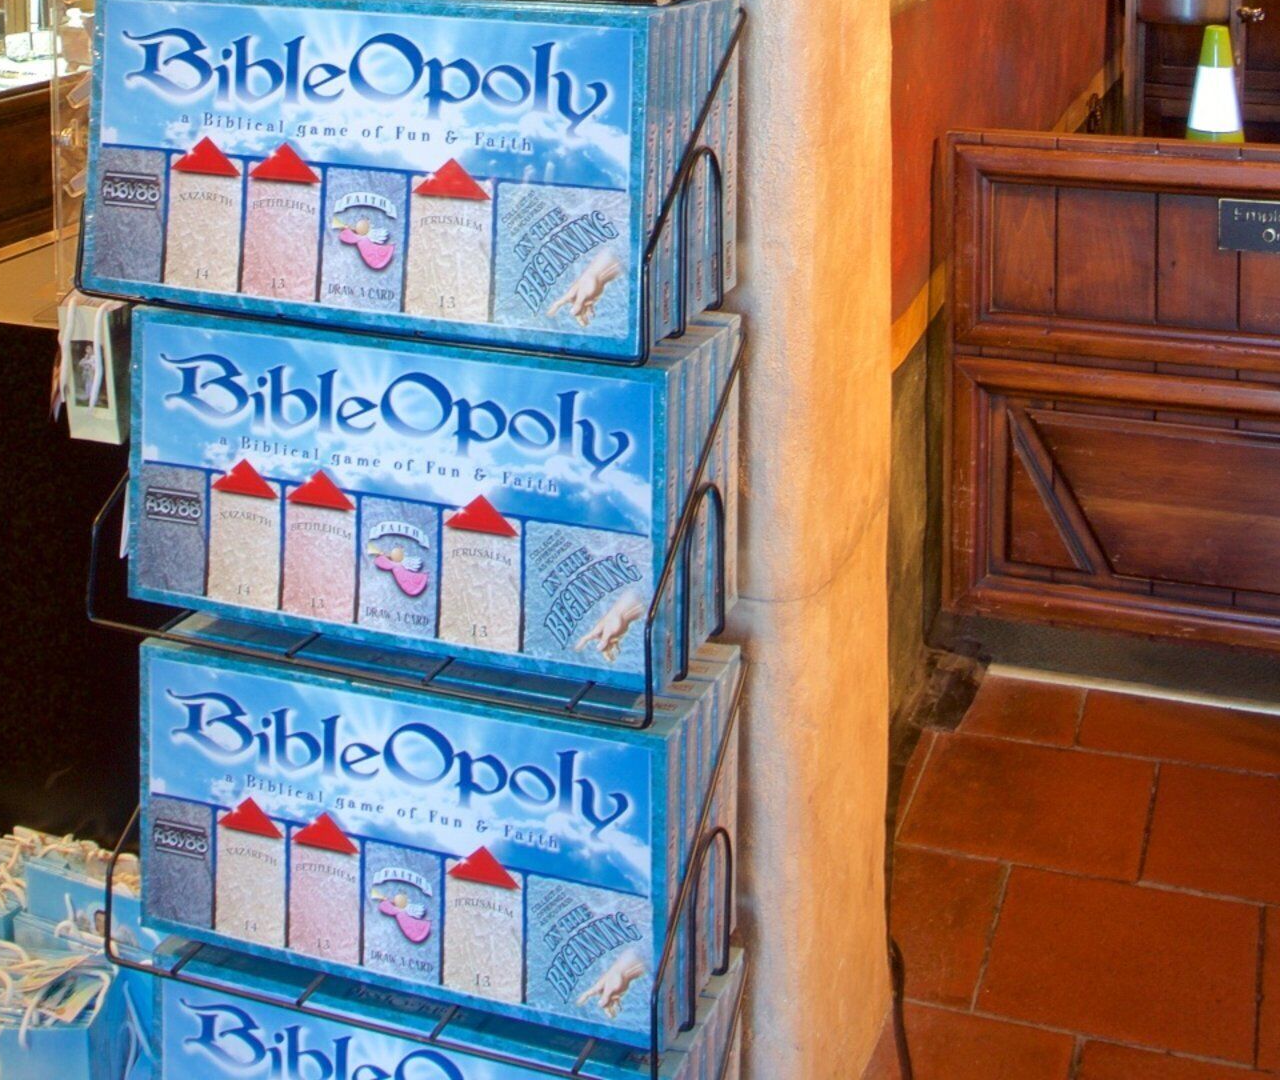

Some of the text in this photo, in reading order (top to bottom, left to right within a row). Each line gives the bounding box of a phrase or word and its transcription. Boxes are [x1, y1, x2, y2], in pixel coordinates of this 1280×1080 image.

[122, 28, 608, 136] BibleOpoly
[181, 112, 534, 152] a Biblical game of Fun & Faith
[346, 195, 387, 207] FAITH
[420, 215, 483, 232] JERUSALEM
[513, 207, 570, 262] IN THE
[196, 268, 209, 280] 14
[515, 210, 620, 315] BEGINNING
[271, 278, 286, 289] 13
[439, 295, 456, 308] 13
[160, 353, 630, 480] BibleOpoly
[220, 436, 558, 493] a Biblical game of Fun & Faith
[380, 523, 419, 537] FAITH
[451, 548, 512, 567] JERUSALEM
[542, 546, 594, 597] IN THE
[542, 552, 643, 650] BEGINNING
[472, 624, 488, 638] 13
[167, 689, 629, 838] BibleOpoly
[225, 774, 559, 849] a Biblical game of Fun & Faith
[384, 869, 423, 884] FAITH
[454, 898, 514, 918] JERUSALEM
[543, 903, 594, 952] IN THE
[545, 911, 643, 1004] BEGINNING
[475, 973, 491, 987] 13
